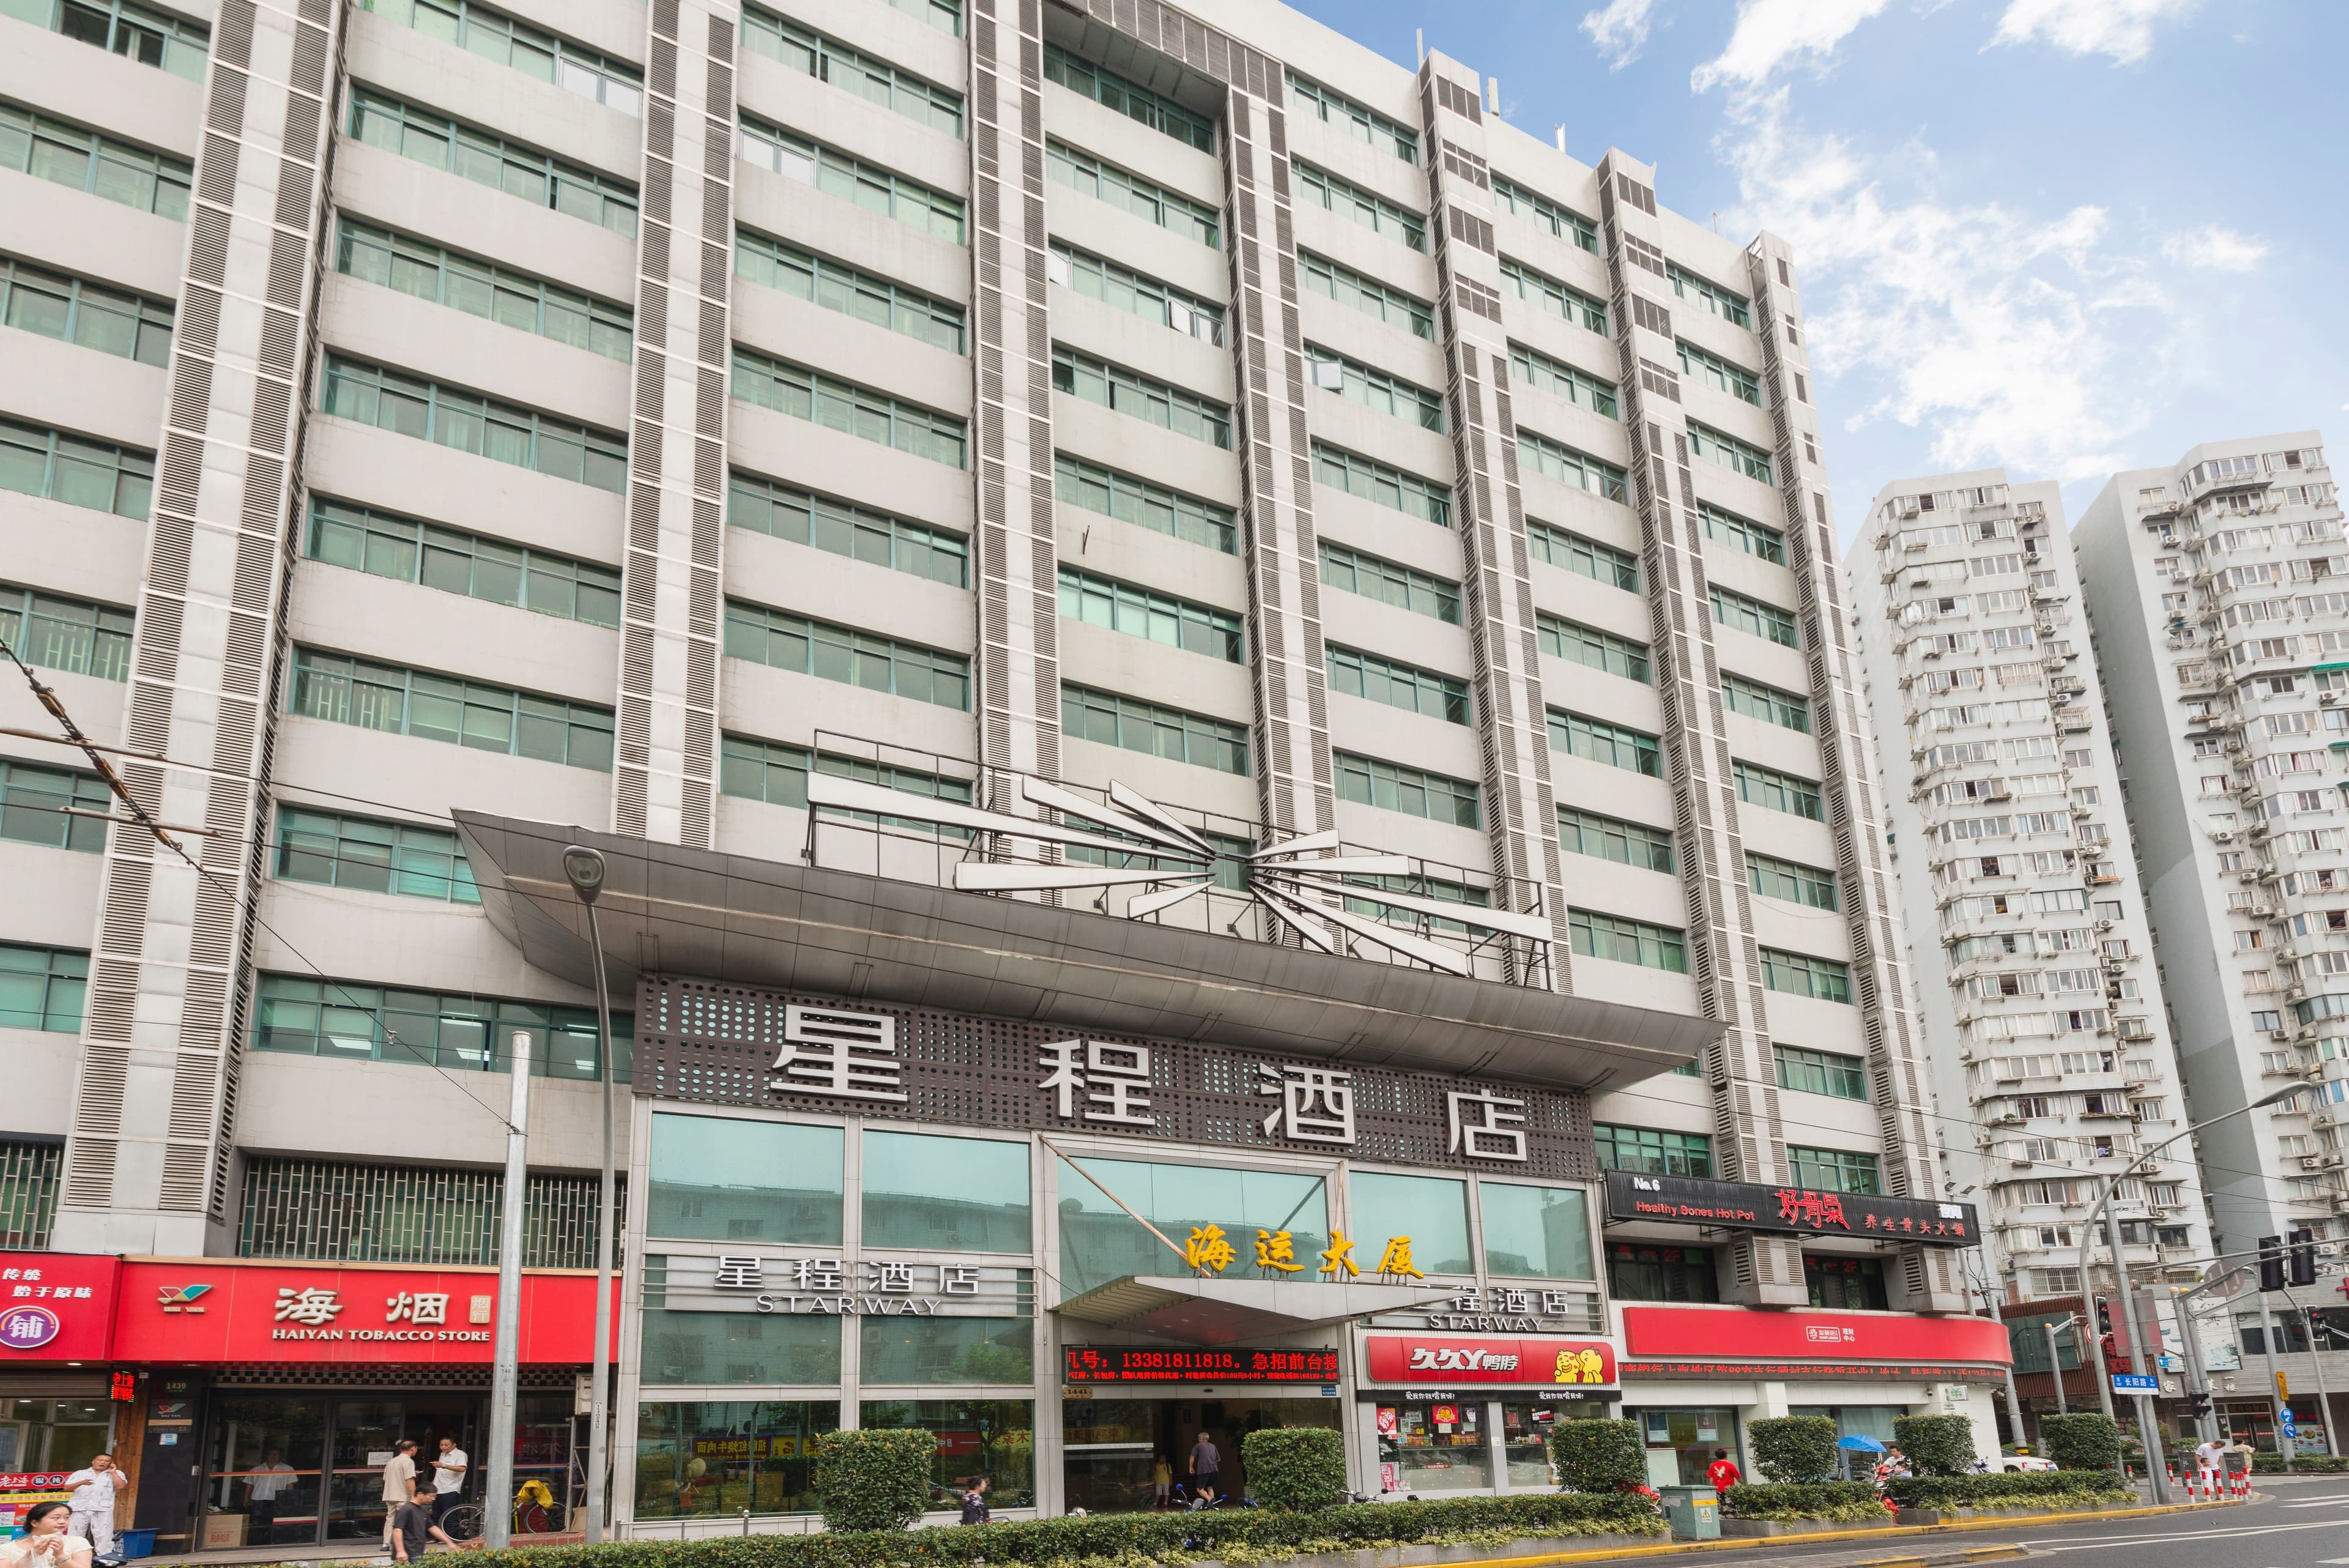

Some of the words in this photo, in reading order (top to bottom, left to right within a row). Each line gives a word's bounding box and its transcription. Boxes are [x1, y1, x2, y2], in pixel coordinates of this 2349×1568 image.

[770, 1003, 1527, 1162] 星程酒店
[1636, 1201, 1677, 1216] Healthy
[1680, 1205, 1713, 1217] Bones
[1716, 1208, 1734, 1219] Hot
[1737, 1210, 1755, 1221] Pot
[1866, 1214, 1965, 1237] 养生骨头火锅
[1185, 1224, 1425, 1279] 海运大厦
[2, 1268, 42, 1280] 传统
[714, 1254, 980, 1296] 星程酒店
[274, 1287, 450, 1326] 海烟
[756, 1294, 942, 1315] STARWAY
[1406, 1283, 1569, 1314] 程酒店
[8, 1315, 46, 1339] 铺
[1429, 1313, 1543, 1331] STARWAY
[272, 1329, 343, 1340] HAIYAN
[348, 1329, 434, 1341] TOBACCO
[438, 1331, 491, 1342] STORE
[2124, 1377, 2147, 1387] 长阳路
